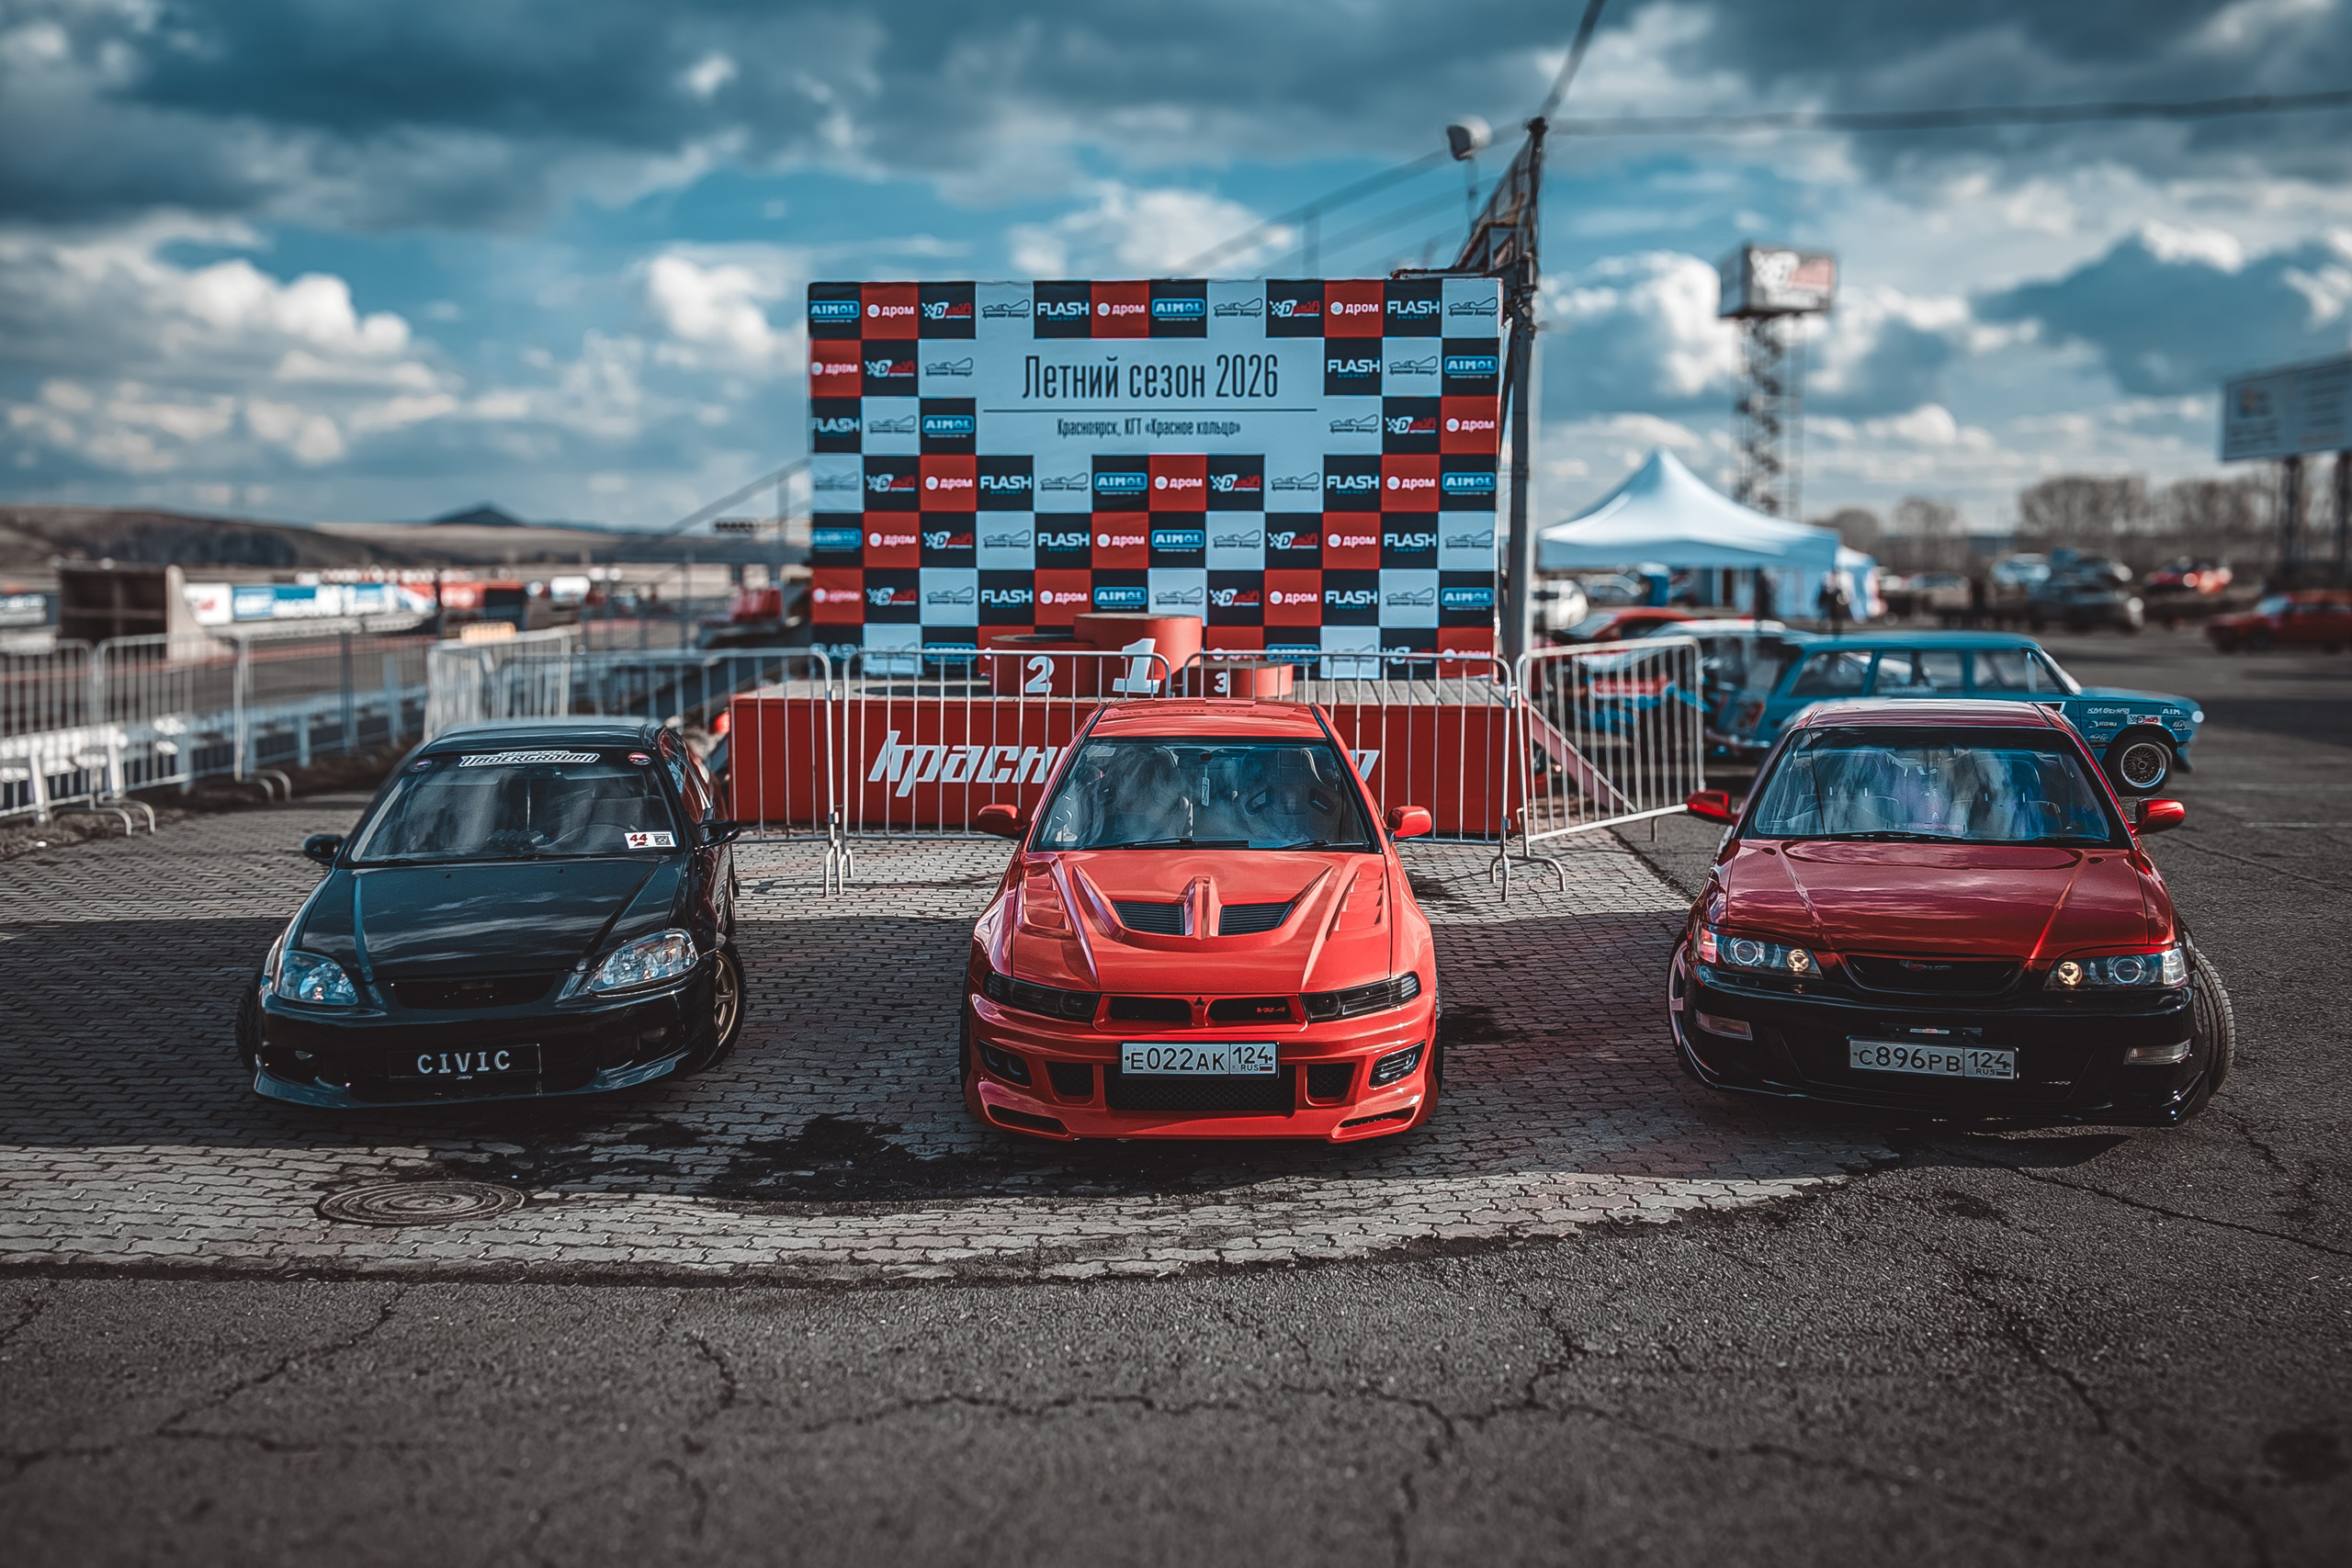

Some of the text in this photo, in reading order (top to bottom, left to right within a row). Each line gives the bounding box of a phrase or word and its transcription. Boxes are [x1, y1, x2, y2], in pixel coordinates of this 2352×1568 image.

[810, 304, 856, 314] AIMOL
[881, 306, 915, 318] дром
[1036, 301, 1090, 316] FLASH
[1112, 304, 1146, 317] дром
[1155, 302, 1202, 313] AIMOL
[1344, 303, 1379, 316] дром
[1386, 300, 1441, 314] FLASH
[1328, 358, 1381, 373] FLASH
[1447, 359, 1493, 370] AIMOL
[1022, 354, 1278, 399] Летний сезон 2026
[925, 419, 970, 430] AIMOL
[1057, 417, 1122, 439] Красноярск,
[1461, 420, 1495, 433] дром
[939, 478, 973, 490] дром
[979, 475, 1033, 490] FLASH
[1169, 478, 1203, 491] дром
[1326, 475, 1380, 490] FLASH
[1401, 478, 1436, 491] дром
[1037, 532, 1091, 547] FLASH
[1111, 535, 1146, 548] дром
[1155, 534, 1201, 545] AIMOL
[1342, 536, 1376, 548] дром
[1384, 533, 1437, 547] FLASH
[980, 589, 1034, 604] FLASH
[1054, 592, 1088, 604] дром
[1283, 592, 1317, 605] дром
[1325, 590, 1378, 604] FLASH
[1113, 637, 1160, 694] 1
[1024, 656, 1055, 693] 2
[1214, 672, 1227, 693] 3
[629, 833, 649, 842] 44
[1232, 1045, 1269, 1065] 124
[1967, 1051, 2008, 1069] 124
[417, 1050, 511, 1074] CIVIC
